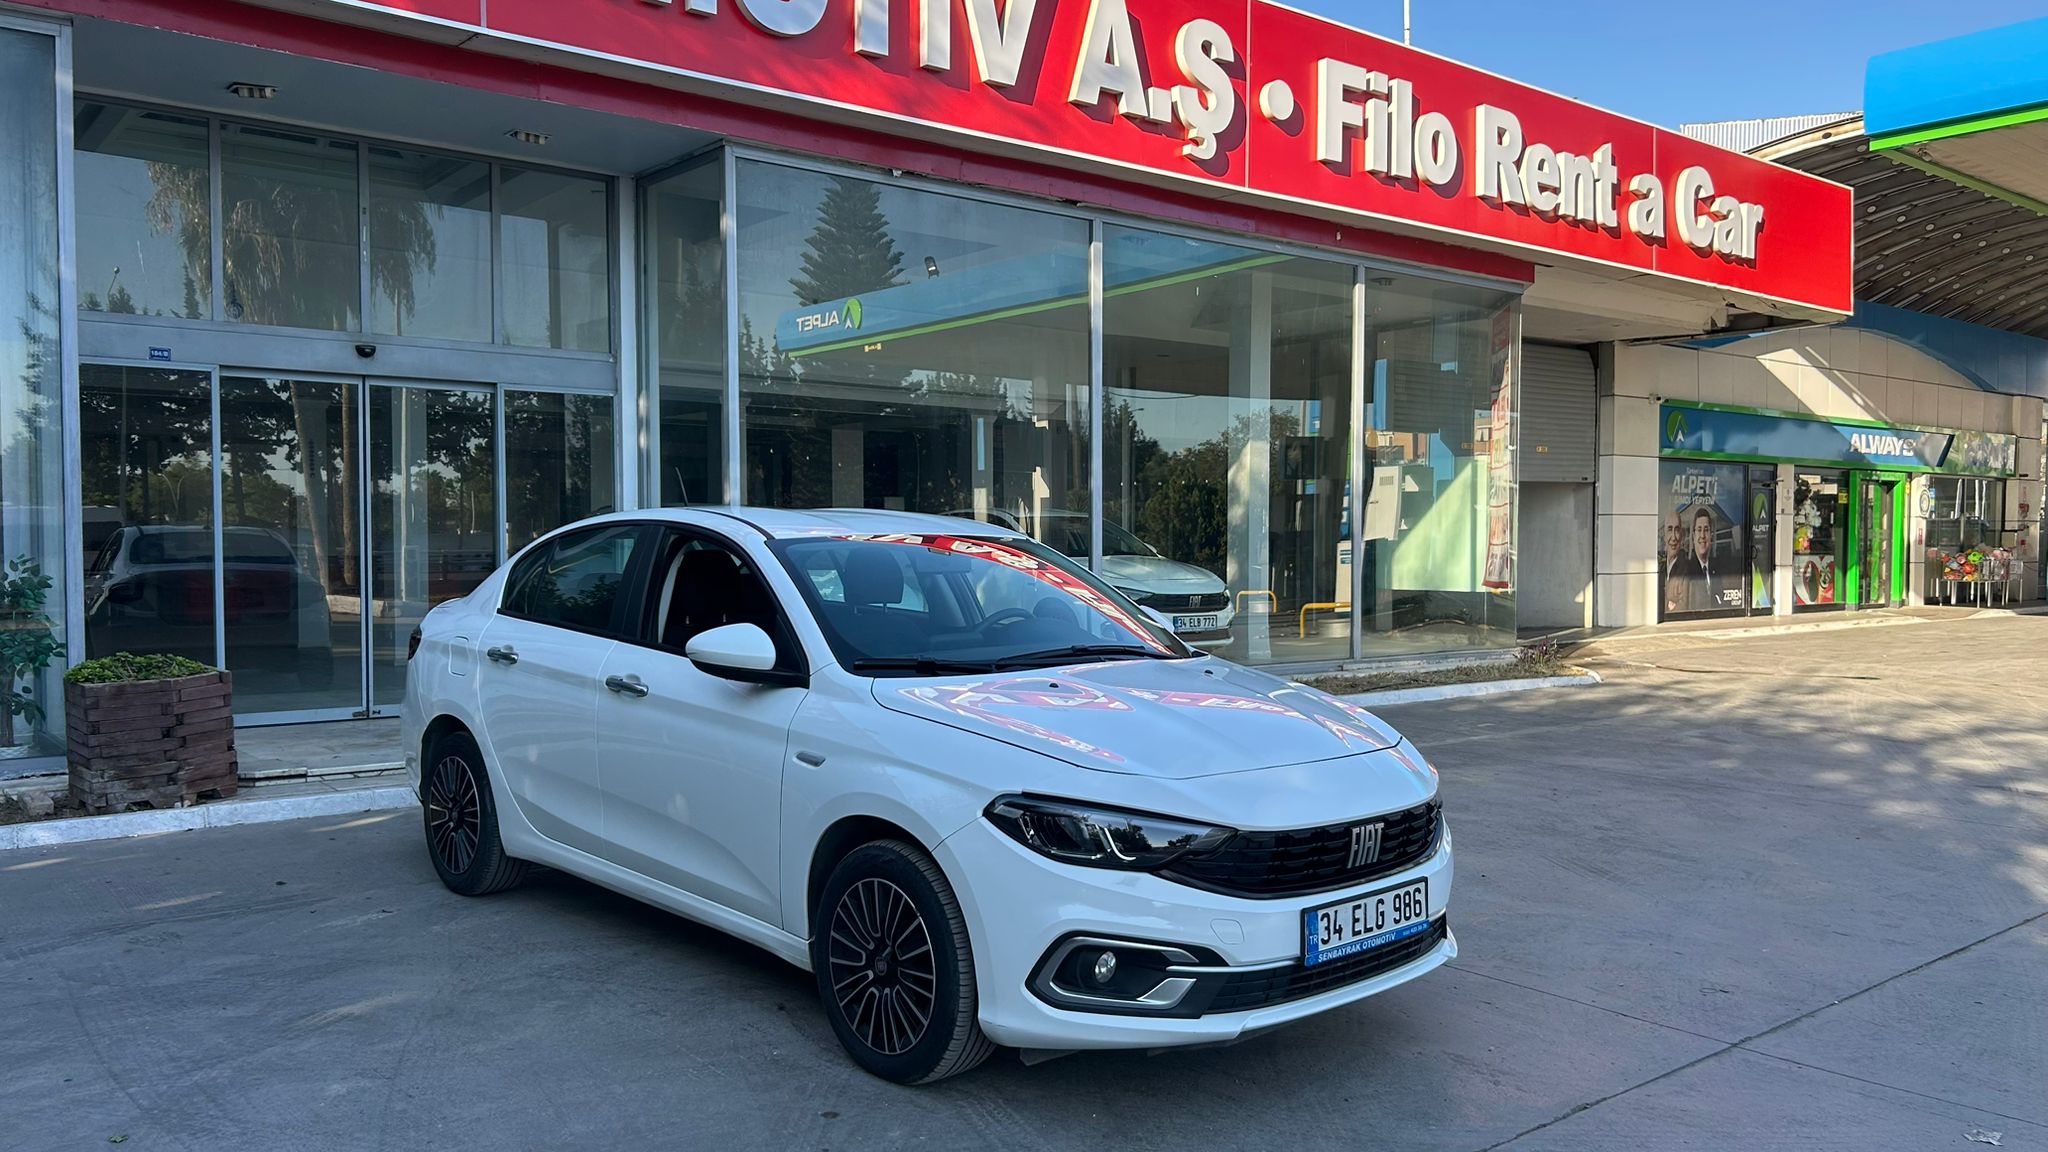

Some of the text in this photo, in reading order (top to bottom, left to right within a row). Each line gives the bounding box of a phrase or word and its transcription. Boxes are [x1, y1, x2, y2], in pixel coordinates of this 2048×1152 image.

[1318, 57, 1457, 185] Filo
[1476, 104, 1618, 228] Rent
[1628, 173, 1664, 238] a
[1675, 165, 1764, 260] Car
[1178, 618, 1187, 628] 34
[1203, 617, 1216, 627] 772
[1347, 822, 1384, 869] FIAT
[1320, 887, 1422, 945] 34 ELG 986
[1309, 935, 1318, 945] TR
